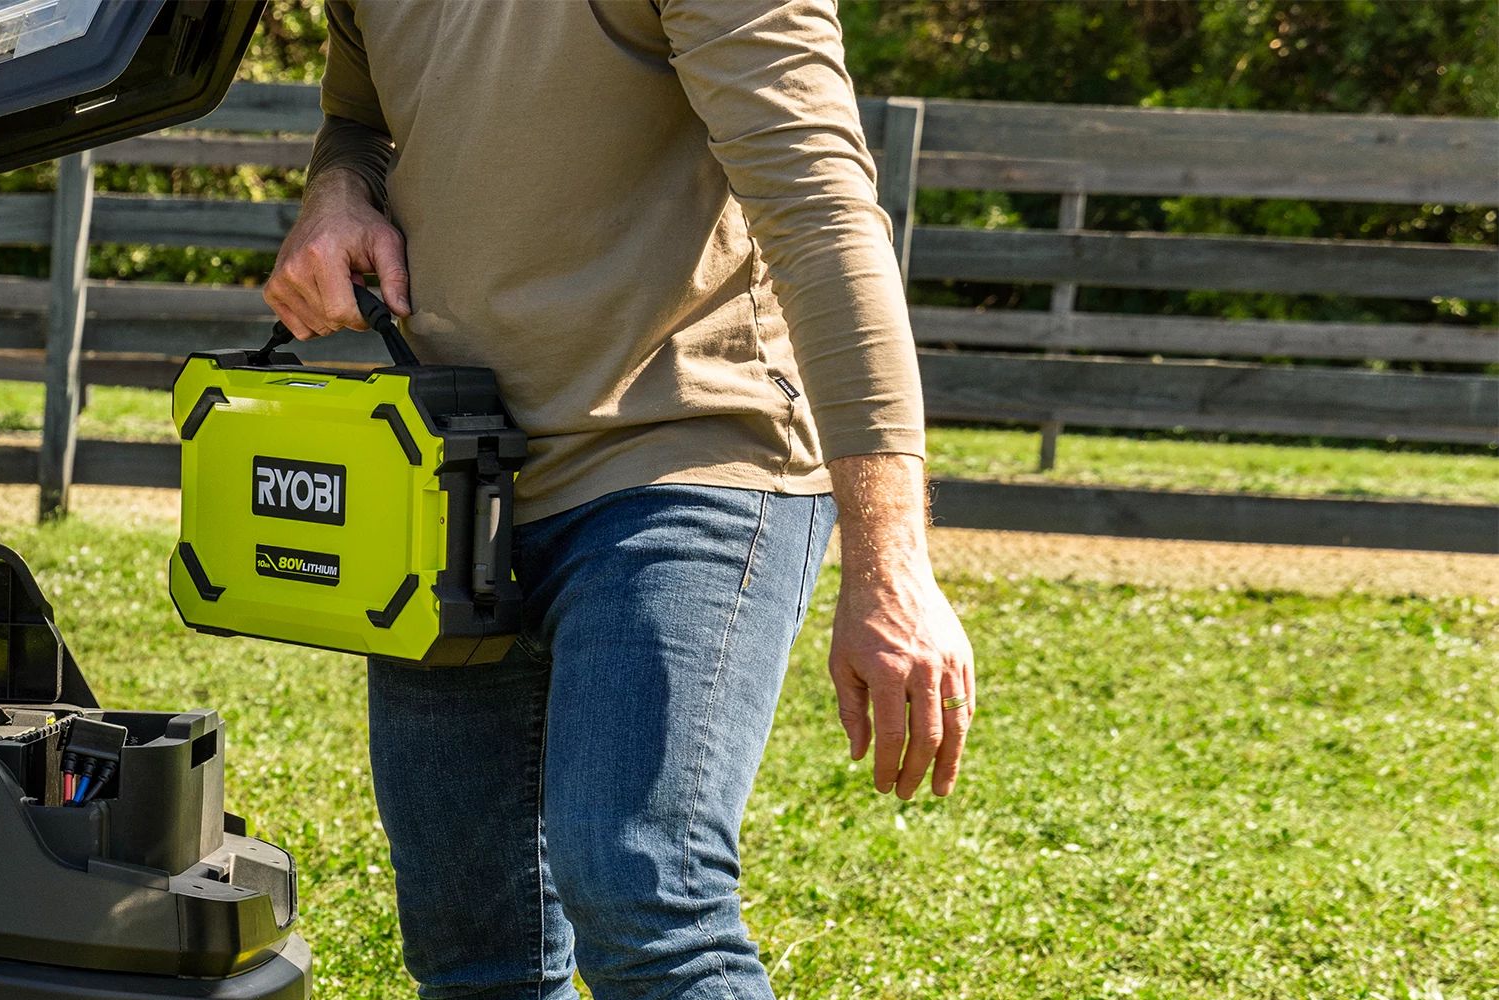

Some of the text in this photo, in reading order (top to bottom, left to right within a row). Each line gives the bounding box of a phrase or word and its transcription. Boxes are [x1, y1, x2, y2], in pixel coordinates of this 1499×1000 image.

[257, 466, 341, 514] RYOBI
[278, 556, 304, 571] 80V
[302, 562, 338, 576] LITHIUM
